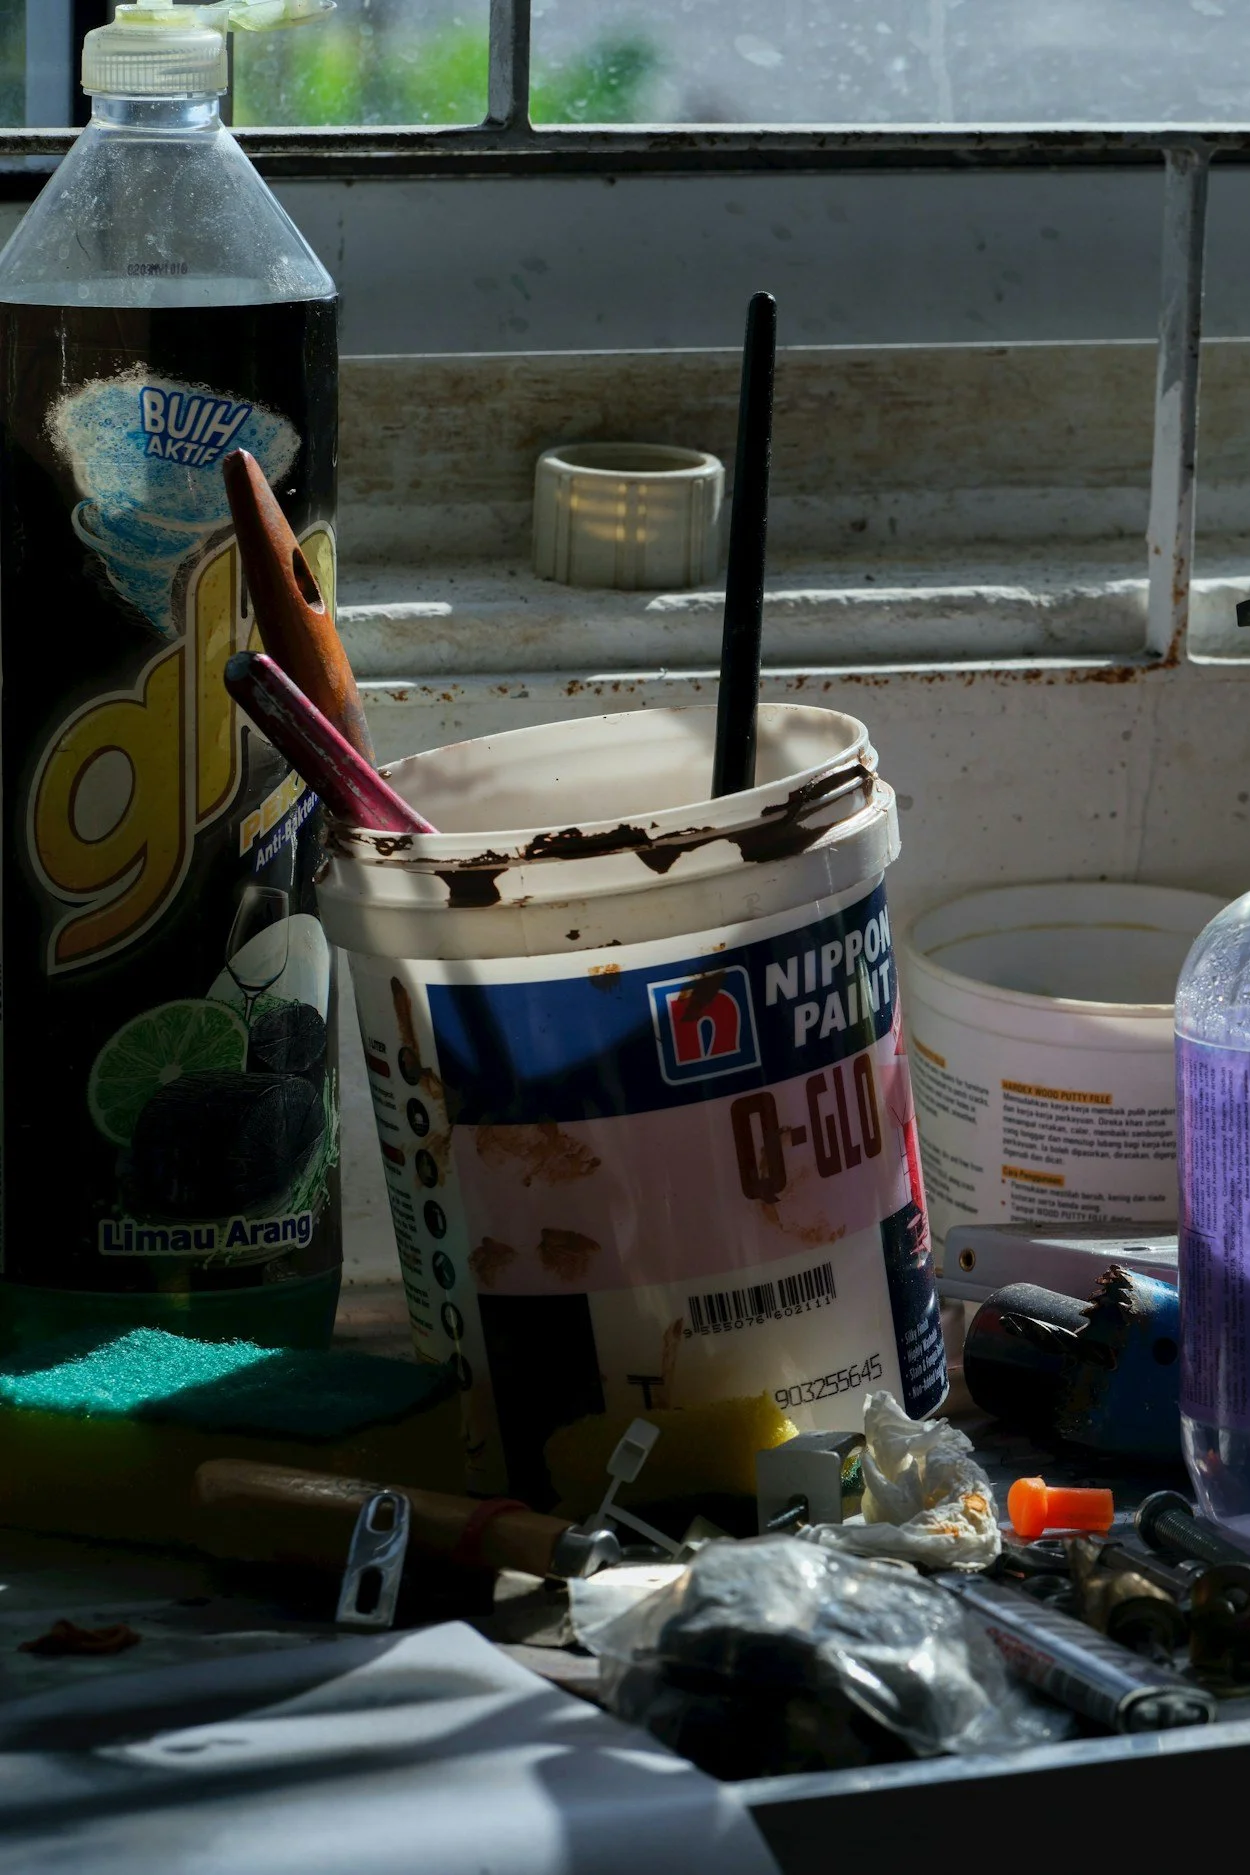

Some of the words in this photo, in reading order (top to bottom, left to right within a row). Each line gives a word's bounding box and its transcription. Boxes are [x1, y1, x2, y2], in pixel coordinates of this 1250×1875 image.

[143, 388, 250, 452] BUIH
[147, 436, 219, 467] AKTIF
[27, 522, 335, 973] gl
[239, 769, 307, 858] PEK
[765, 903, 891, 1007] NIPPON
[794, 960, 891, 1049] PAINT
[1003, 1081, 1032, 1093] HARDEX
[1035, 1088, 1059, 1099] WOOD
[1061, 1090, 1087, 1102] PUTTY
[730, 1053, 882, 1202] Q-GLO
[1098, 1117, 1123, 1126] Direka
[101, 1219, 215, 1253] Limau
[224, 1213, 313, 1251] Arang
[1037, 1208, 1059, 1217] WOOD
[1061, 1210, 1086, 1220] PUTTY
[774, 1296, 831, 1320] 602111
[774, 1353, 883, 1410] 903255645
